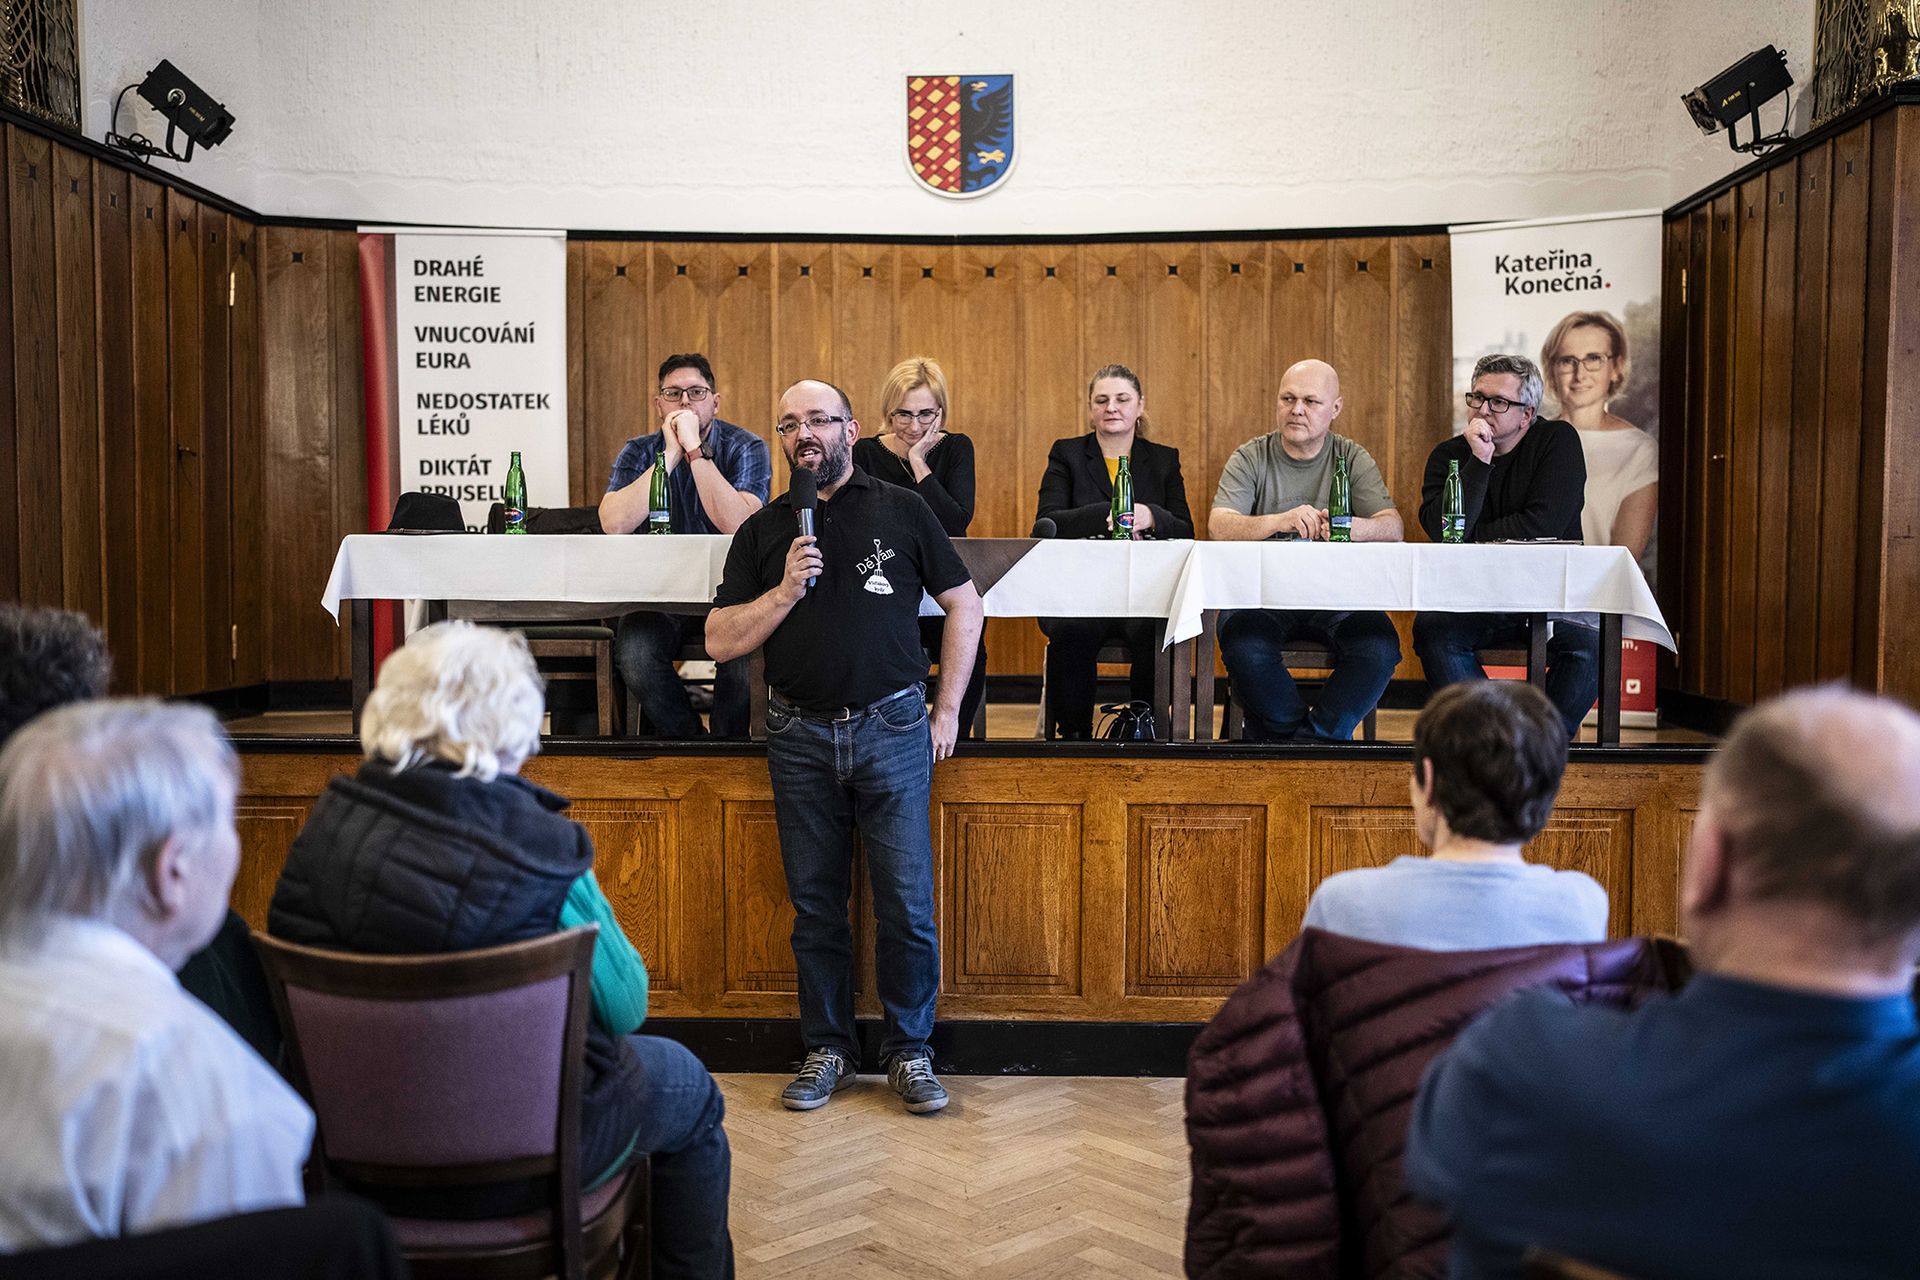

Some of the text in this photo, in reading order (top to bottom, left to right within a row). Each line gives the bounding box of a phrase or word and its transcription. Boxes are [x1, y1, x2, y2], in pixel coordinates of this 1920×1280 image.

[414, 255, 484, 277] DRAHÉ
[1495, 249, 1592, 274] Kateřina
[414, 286, 501, 303] ENERGIE
[414, 321, 535, 343] VNUCOVÁNÍ
[416, 352, 471, 369] EURA
[417, 393, 550, 409] NEDOSTATEK
[417, 412, 470, 435] LÉKŮ
[419, 454, 492, 476] DIKTÁT
[420, 485, 505, 501] BRUSEL
[856, 548, 896, 575] Dělám
